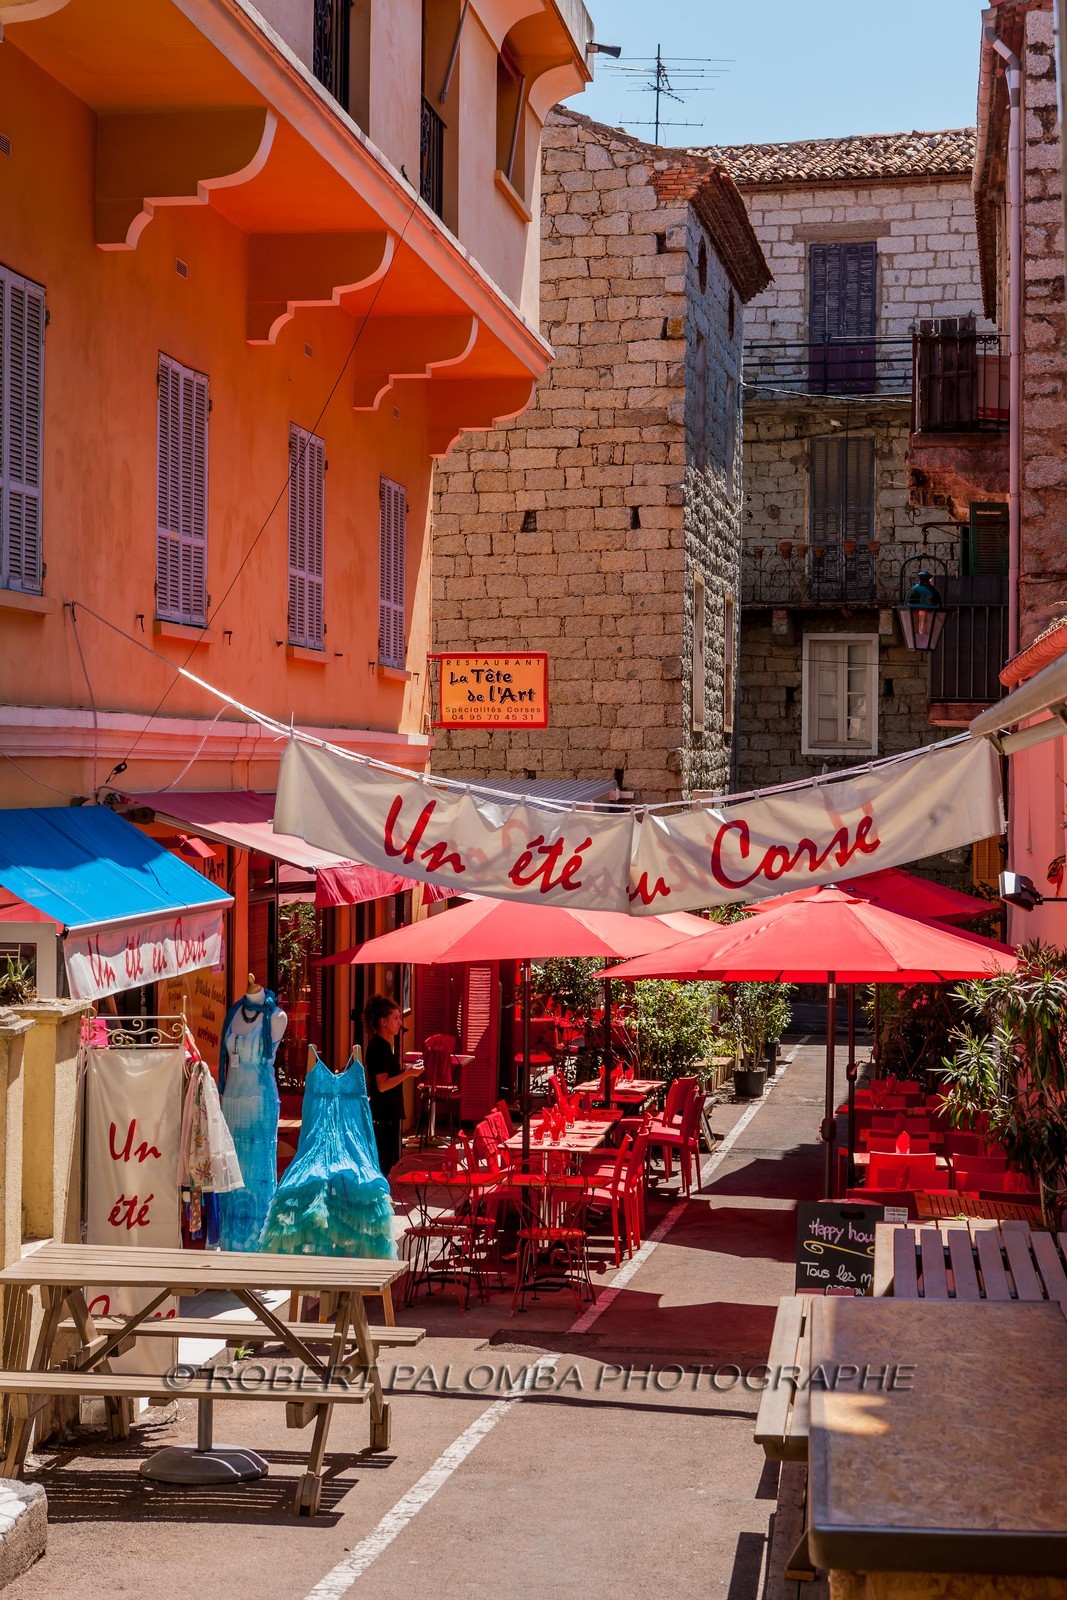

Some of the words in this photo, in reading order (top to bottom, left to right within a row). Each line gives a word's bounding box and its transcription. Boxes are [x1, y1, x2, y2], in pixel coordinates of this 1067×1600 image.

[449, 671, 469, 685] La
[470, 668, 513, 684] Tête
[467, 689, 485, 702] de
[489, 685, 536, 704] l'Art
[445, 706, 502, 714] Spécialités
[383, 794, 466, 873] Un
[507, 834, 593, 894] été
[710, 814, 881, 890] Corse
[87, 933, 116, 988] Un
[125, 932, 144, 981] été
[173, 916, 207, 969] Corse
[108, 1118, 162, 1164] Un
[107, 1193, 155, 1231] été
[808, 1218, 845, 1244] Happy
[848, 1221, 876, 1243] hou
[800, 1261, 830, 1279] Tous
[836, 1264, 857, 1282] les
